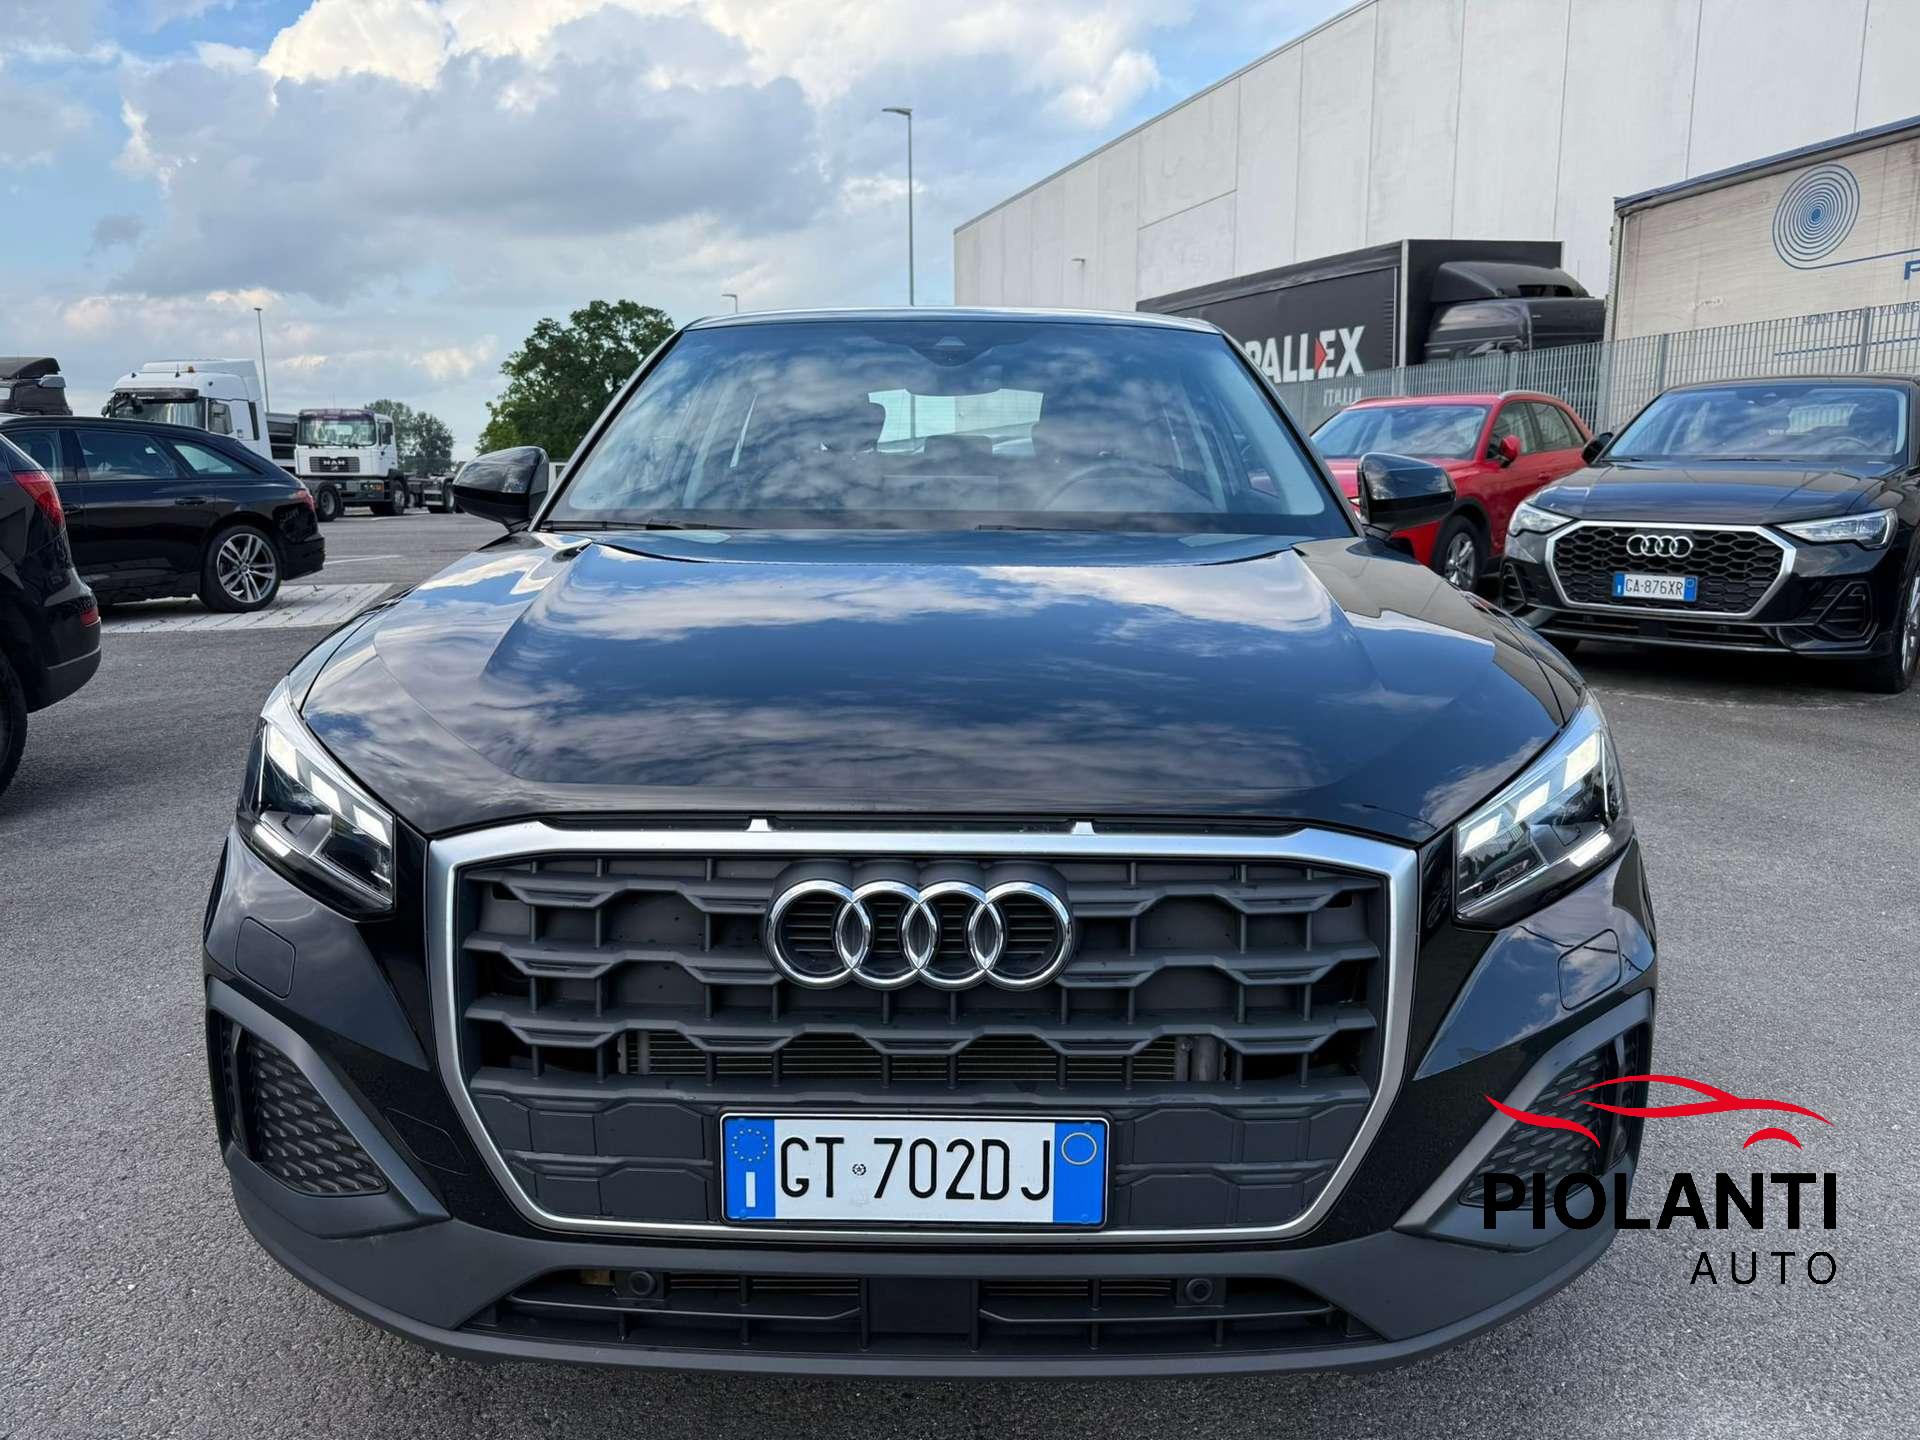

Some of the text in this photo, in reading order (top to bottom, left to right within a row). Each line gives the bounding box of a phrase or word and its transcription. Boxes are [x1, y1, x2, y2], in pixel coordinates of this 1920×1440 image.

[1244, 325, 1365, 383] PALLEX
[1643, 579, 1684, 596] 876XR
[780, 1136, 1051, 1201] GT 702DJ
